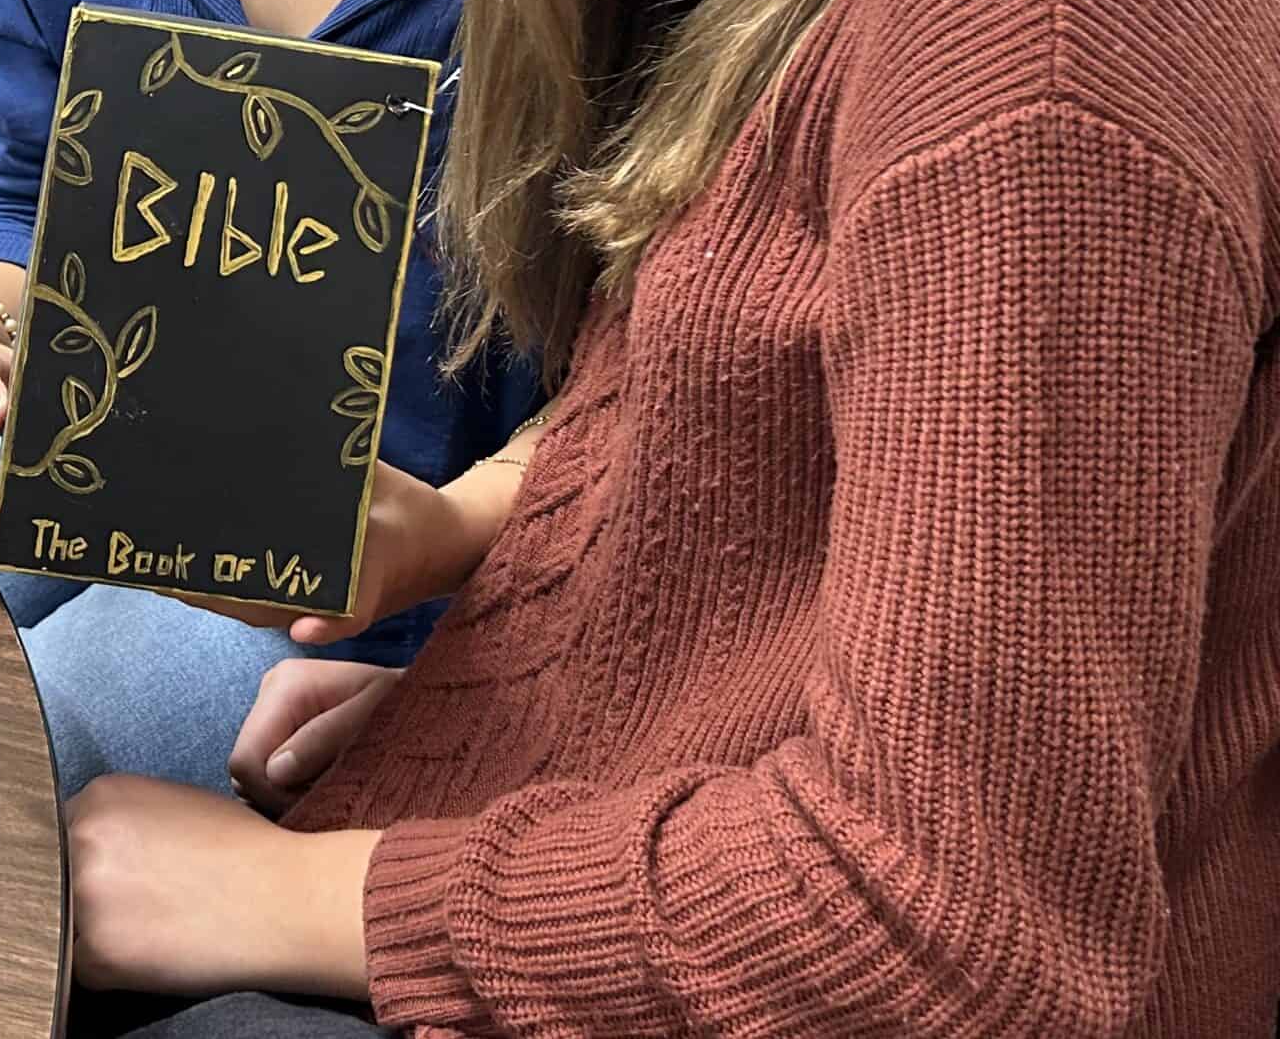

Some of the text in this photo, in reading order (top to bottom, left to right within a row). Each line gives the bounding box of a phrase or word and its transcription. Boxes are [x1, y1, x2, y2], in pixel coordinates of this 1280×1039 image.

[31, 519, 88, 561] The
[107, 531, 196, 580] Book
[265, 549, 322, 597] Viv
